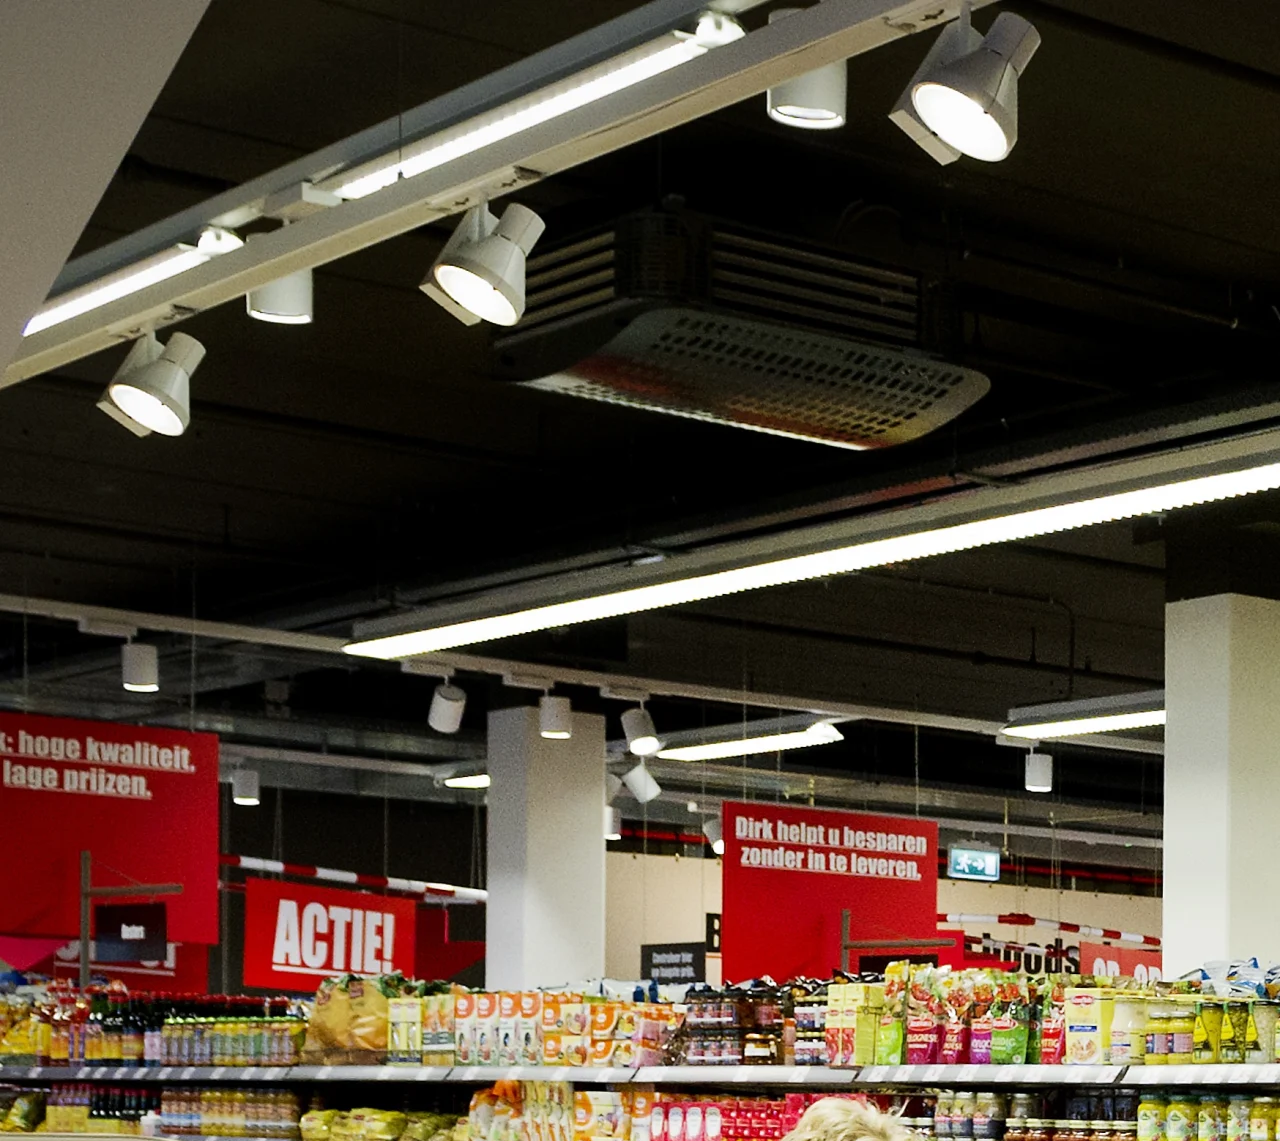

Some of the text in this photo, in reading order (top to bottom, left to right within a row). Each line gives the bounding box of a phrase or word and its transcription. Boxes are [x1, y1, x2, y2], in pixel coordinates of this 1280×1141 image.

[18, 730, 81, 761] hoge
[86, 736, 197, 773] kwaliteit.
[3, 760, 153, 799] lage prijzen.
[735, 816, 927, 854] Dirk helpt u besparen
[740, 846, 922, 881] zonder in te leveren.
[272, 898, 395, 975] ACTIE!
